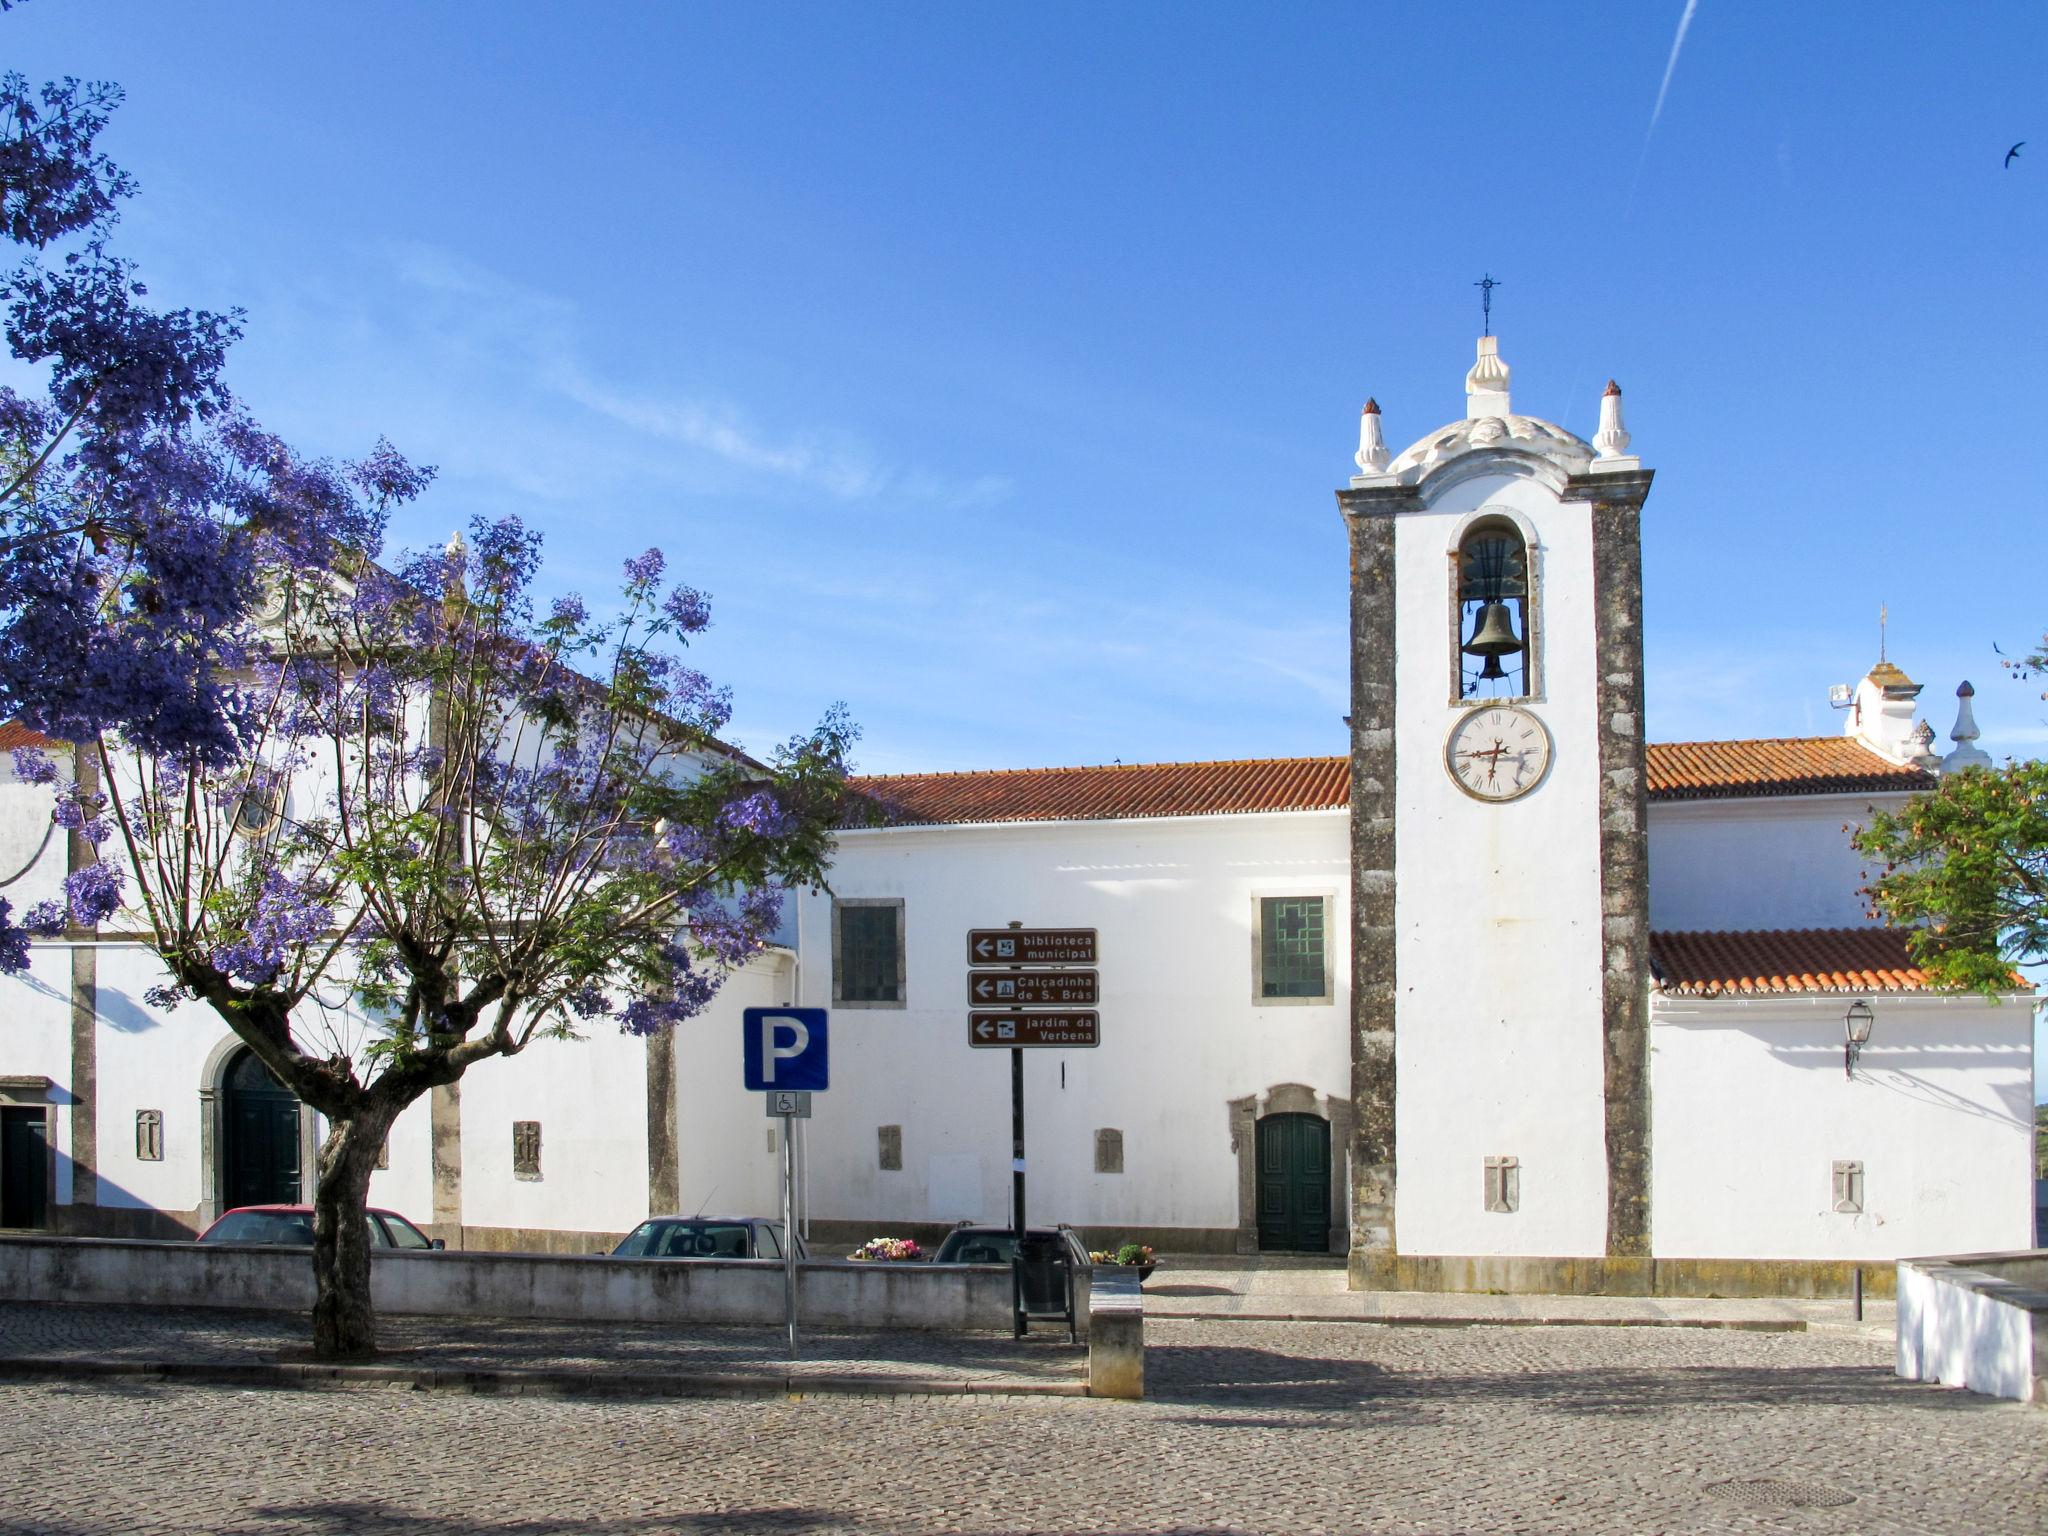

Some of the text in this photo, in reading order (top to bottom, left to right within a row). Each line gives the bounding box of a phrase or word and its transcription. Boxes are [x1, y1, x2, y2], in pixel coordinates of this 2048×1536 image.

[1024, 936, 1092, 946] biblioteca
[1028, 949, 1092, 959] municipal
[1017, 978, 1092, 988] Calçadinha
[1018, 991, 1033, 1000] de
[1041, 990, 1054, 1000] S.
[1027, 1018, 1092, 1029] jardim da
[1040, 1031, 1092, 1040] Verbena
[762, 1016, 809, 1082] P
